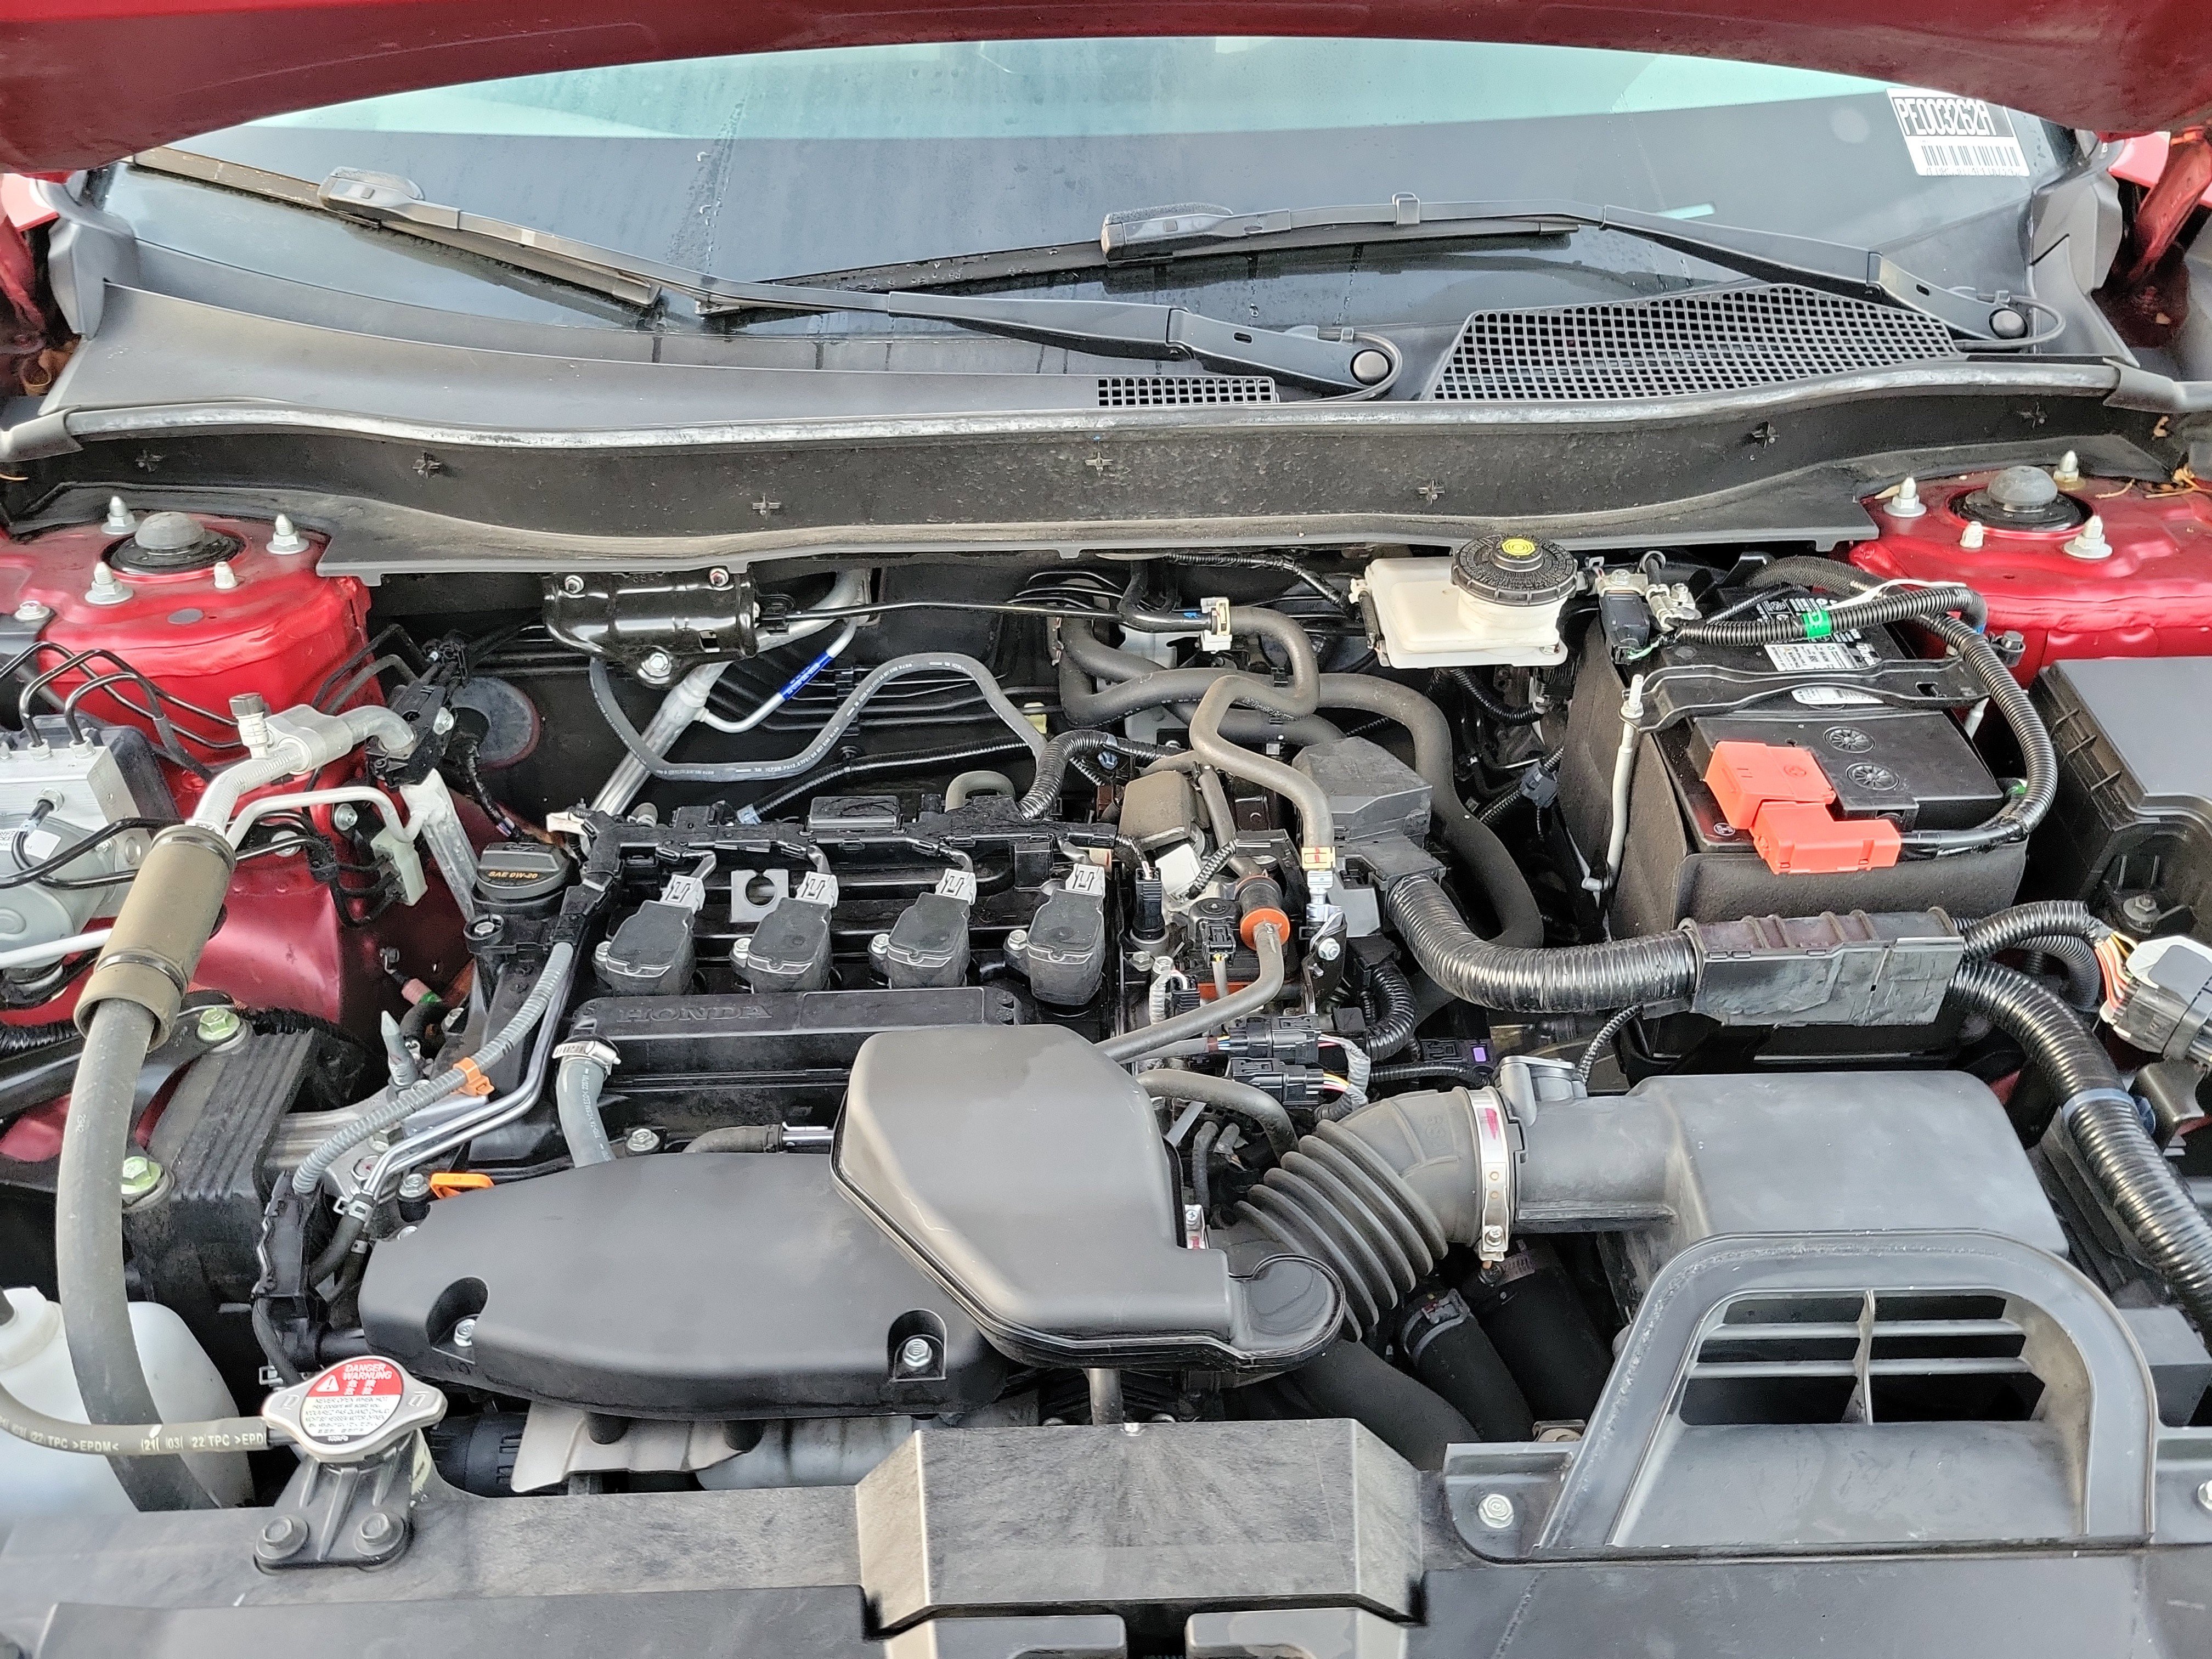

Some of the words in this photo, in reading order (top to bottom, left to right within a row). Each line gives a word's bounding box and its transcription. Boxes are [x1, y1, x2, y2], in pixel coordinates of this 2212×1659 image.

[1894, 99, 1996, 136] PE003262A
[617, 1005, 774, 1023] HONDA
[345, 1363, 386, 1372] DANGER
[343, 1370, 393, 1380] WARNUNG
[47, 1435, 68, 1448] TPC
[208, 1434, 230, 1447] TPC
